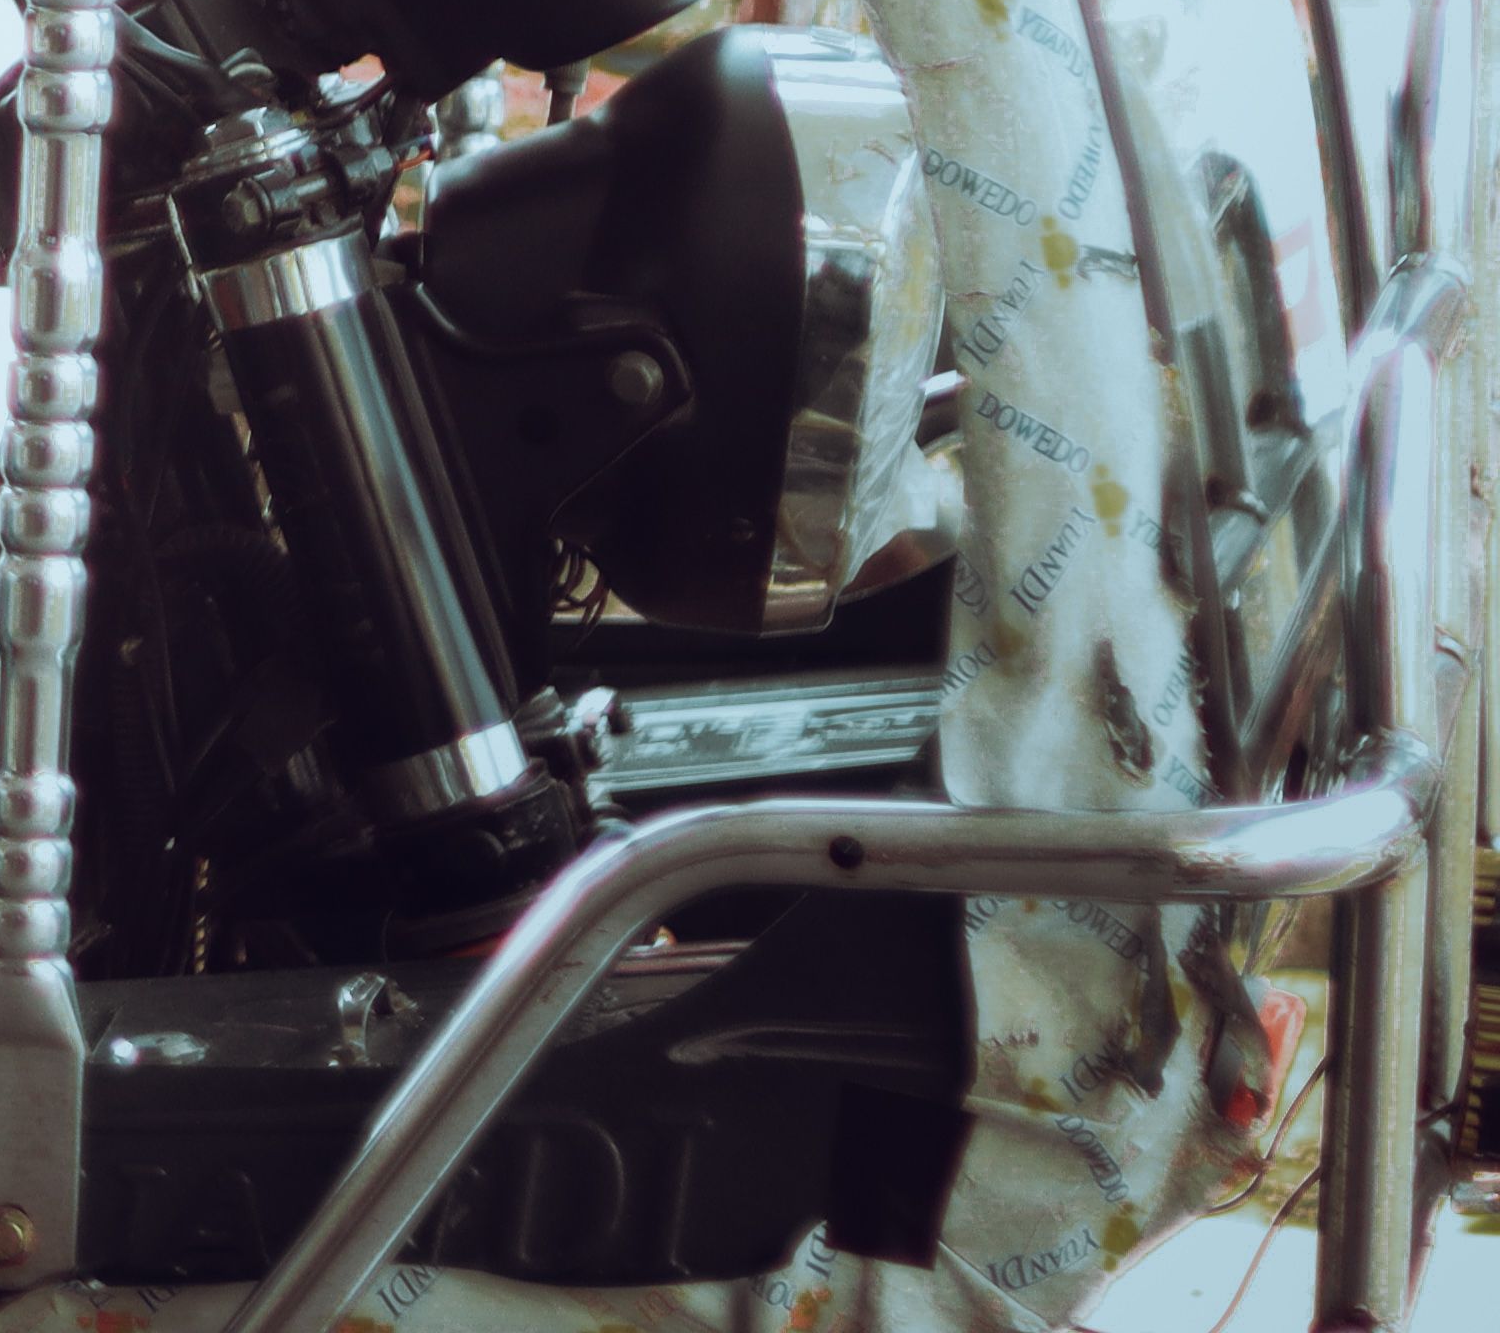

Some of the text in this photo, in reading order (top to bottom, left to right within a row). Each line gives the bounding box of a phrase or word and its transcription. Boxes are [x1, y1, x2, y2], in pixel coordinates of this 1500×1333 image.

[921, 148, 1036, 227] DOWEDO
[961, 259, 1045, 369] YUANDI
[976, 393, 1090, 473] DOWEDO
[1010, 507, 1096, 617] YUANDI
[986, 1229, 1101, 1290] YUANDI
